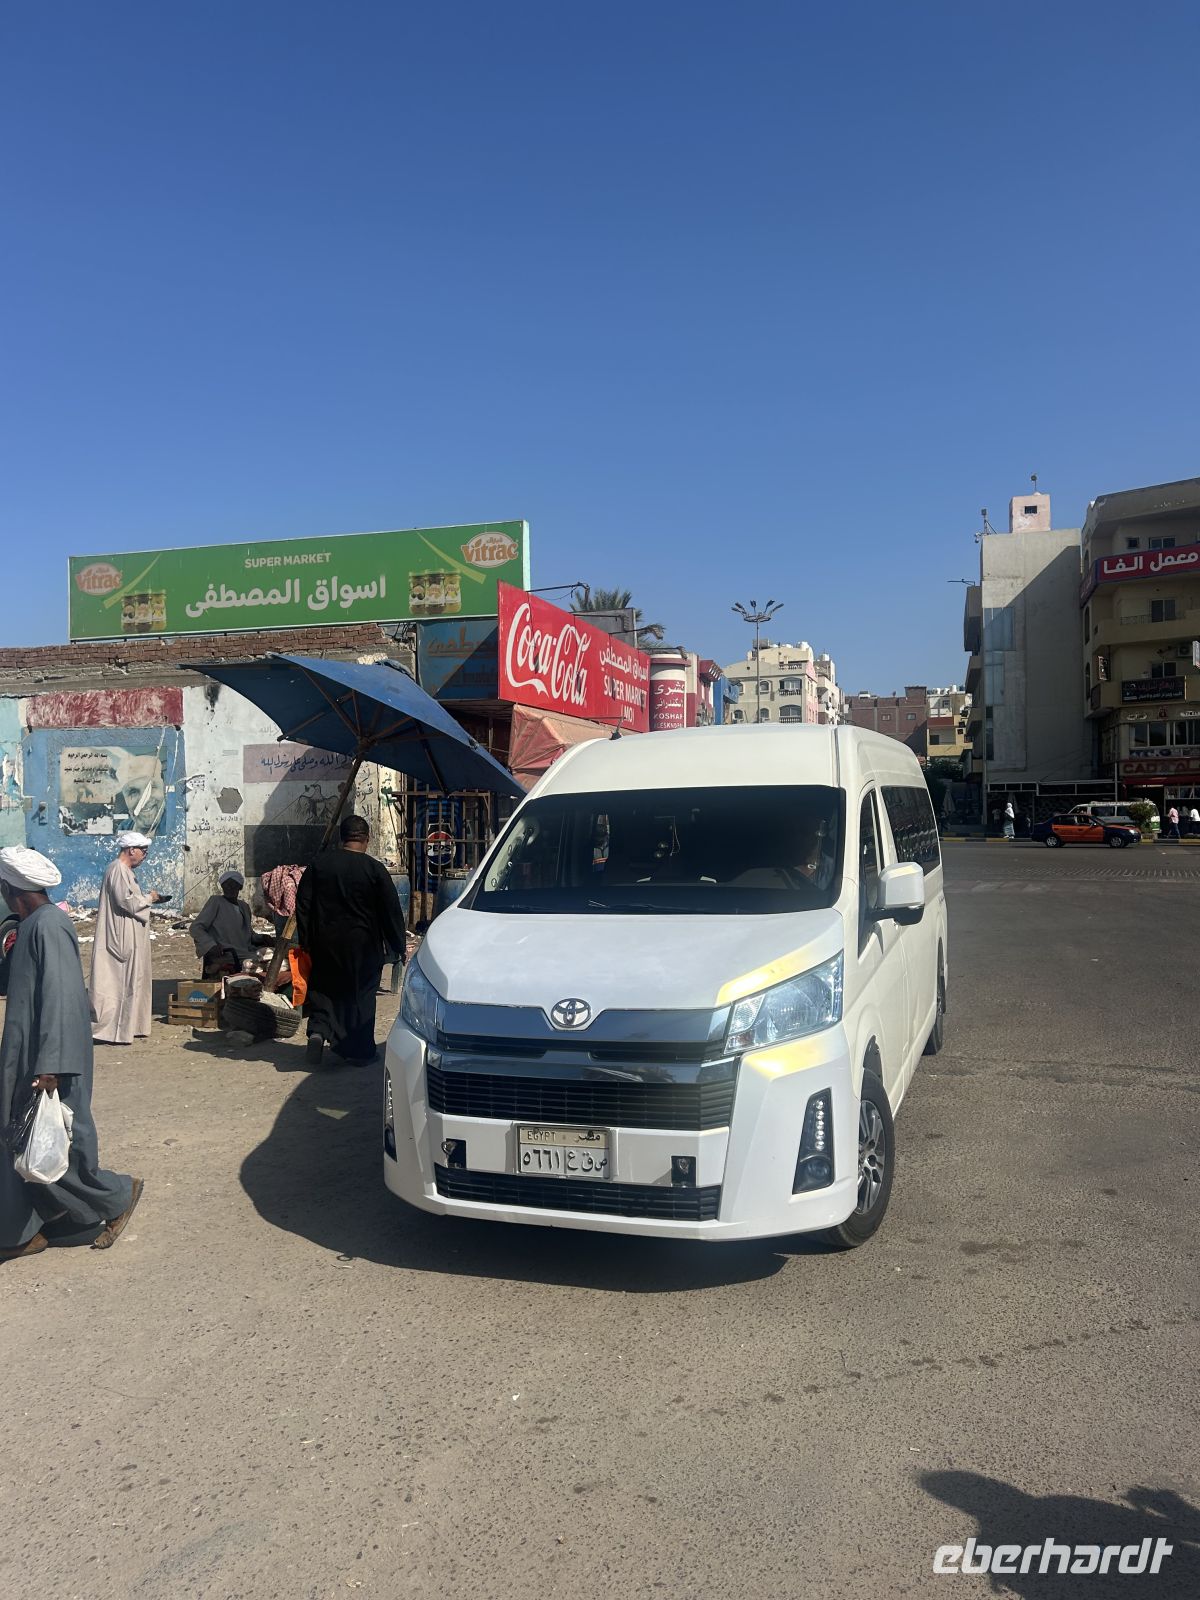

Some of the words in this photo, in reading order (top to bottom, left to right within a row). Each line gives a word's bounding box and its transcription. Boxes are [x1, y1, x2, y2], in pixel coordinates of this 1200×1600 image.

[244, 556, 282, 569] SUPER
[283, 552, 332, 566] MARKET
[461, 539, 519, 563] Vitrac
[1149, 552, 1199, 572] معمل
[1103, 556, 1144, 574] الفا
[185, 578, 300, 618] المصطفى
[307, 575, 387, 611] اسواق
[506, 603, 592, 706] Coca-Cola
[603, 675, 625, 701] SUPER
[625, 683, 648, 710] MARKET
[427, 844, 454, 852] PEPS
[527, 1129, 556, 1142] EGYPT
[574, 1130, 601, 1144] مصر
[522, 1148, 560, 1172] ٥٦٦١
